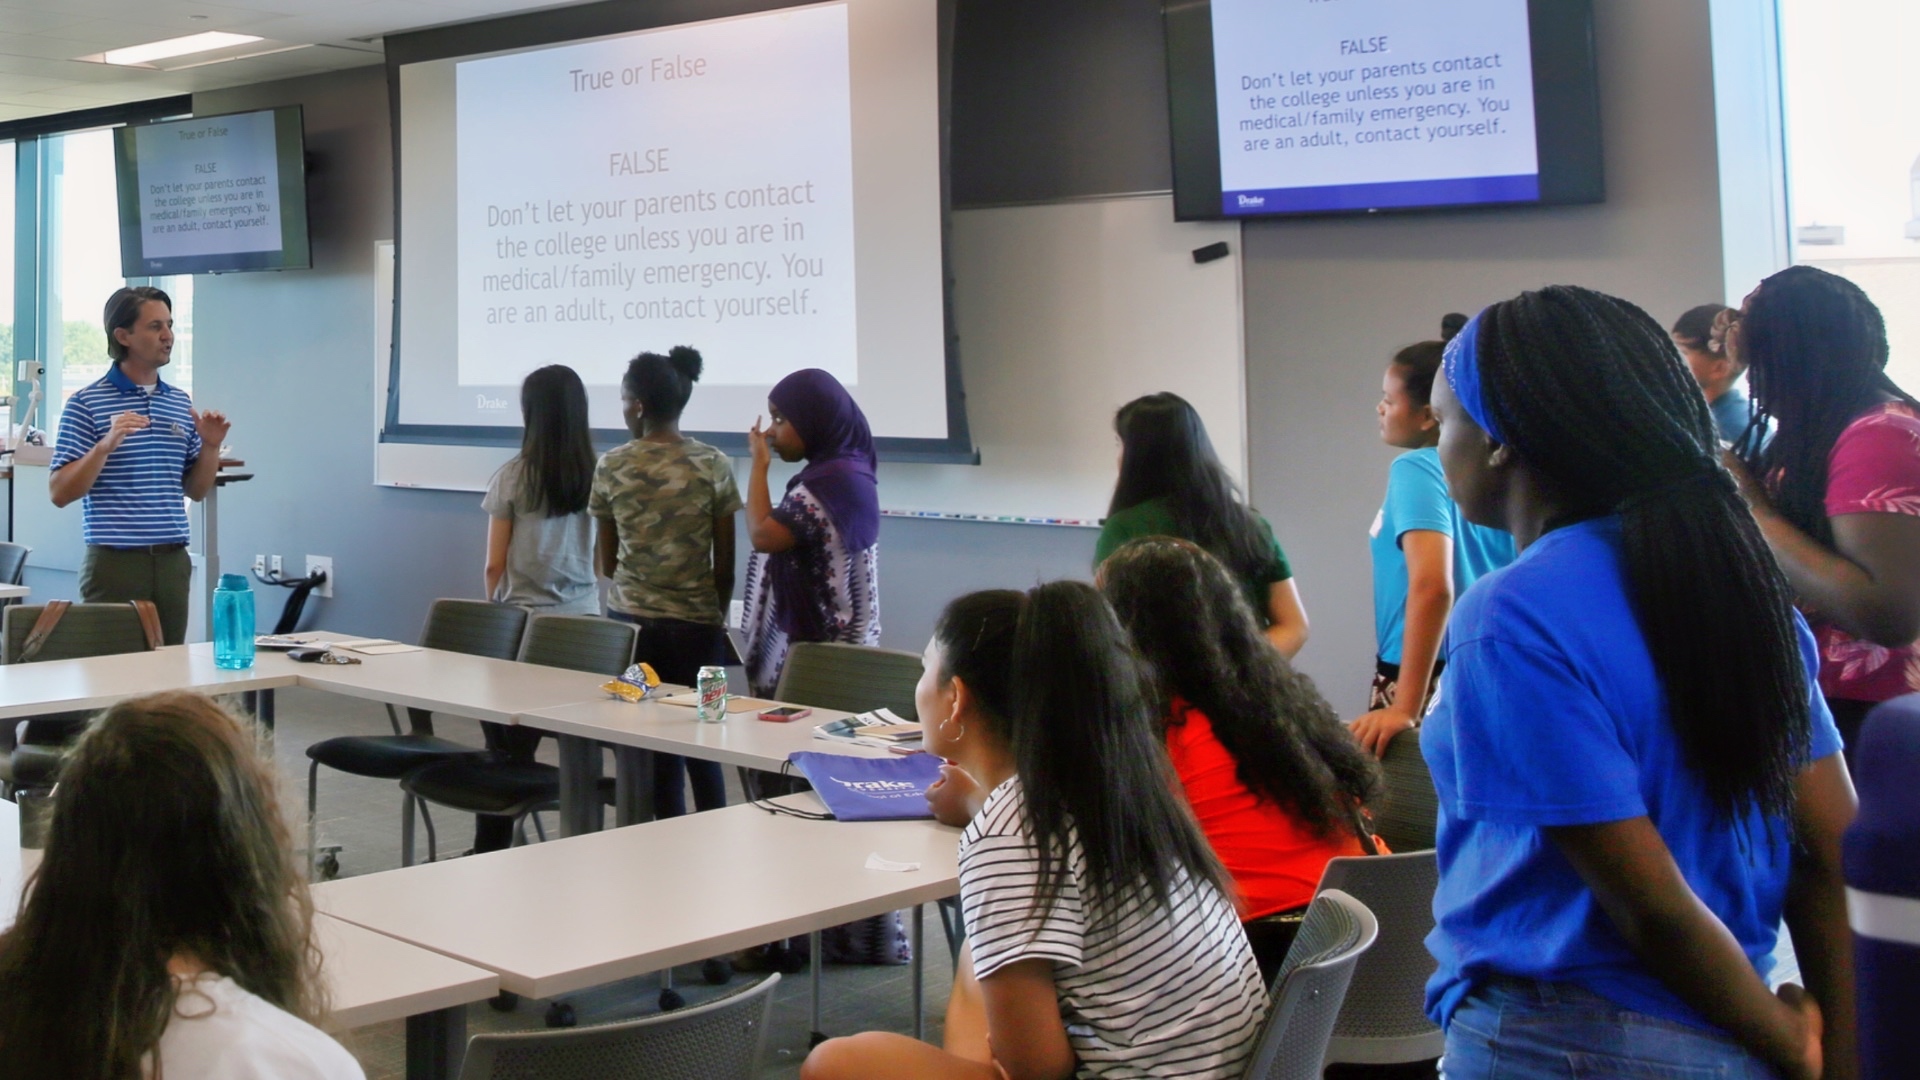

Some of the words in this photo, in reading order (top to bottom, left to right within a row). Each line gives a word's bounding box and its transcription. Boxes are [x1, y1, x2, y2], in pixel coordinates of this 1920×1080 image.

[1340, 36, 1388, 55] FALSE
[570, 68, 613, 93] True
[622, 65, 644, 86] or
[651, 54, 707, 82] False
[1242, 73, 1284, 90] Don't
[1290, 70, 1312, 86] let
[1319, 68, 1354, 91] your
[1362, 61, 1426, 84] parents
[1433, 53, 1501, 73] contact
[1251, 95, 1275, 110] the
[1281, 89, 1340, 108] college
[1346, 84, 1398, 103] unless
[1404, 82, 1435, 100] you
[1442, 78, 1471, 94] are
[1479, 75, 1495, 91] in
[1240, 109, 1364, 132] medical/family
[1370, 102, 1470, 123] emergency.
[1478, 97, 1510, 113] You
[179, 130, 195, 140] True
[198, 129, 205, 138] or
[208, 127, 228, 137] False
[1244, 138, 1268, 151] are
[1276, 135, 1293, 150] an
[1300, 131, 1347, 148] adult,
[1355, 126, 1420, 145] contact
[1427, 119, 1506, 142] yourself.
[195, 163, 216, 174] FALSE
[610, 149, 669, 176] FALSE
[150, 184, 170, 194] Don't
[173, 182, 183, 192] let
[186, 183, 201, 196] your
[204, 180, 233, 195] parents
[236, 176, 266, 187] contact
[154, 197, 166, 207] the
[169, 194, 195, 209] college
[198, 192, 222, 203] unless
[224, 191, 238, 204] you
[241, 191, 253, 200] are
[256, 189, 263, 199] in
[151, 207, 207, 220] medical/family
[209, 206, 253, 219] emergency.
[256, 203, 270, 212] You
[488, 202, 539, 227] Don't
[548, 200, 573, 223] let
[581, 196, 626, 226] your
[635, 189, 716, 222] parents
[724, 180, 815, 209] contact
[153, 225, 164, 233] are
[167, 224, 175, 233] an
[178, 221, 200, 232] adult,
[203, 219, 231, 230] contact
[234, 216, 268, 230] yourself.
[496, 237, 527, 259] the
[534, 232, 606, 259] college
[615, 226, 680, 251] unless
[688, 225, 727, 253] you
[736, 220, 774, 244] are
[783, 217, 804, 241] in
[483, 263, 635, 292] medical/family
[644, 258, 771, 288] emergency.
[782, 253, 823, 278] You
[486, 305, 517, 324] are
[525, 304, 547, 323] an
[554, 298, 614, 325] adult,
[623, 294, 706, 320] contact
[714, 289, 817, 323] yourself.
[475, 394, 508, 409] Drake
